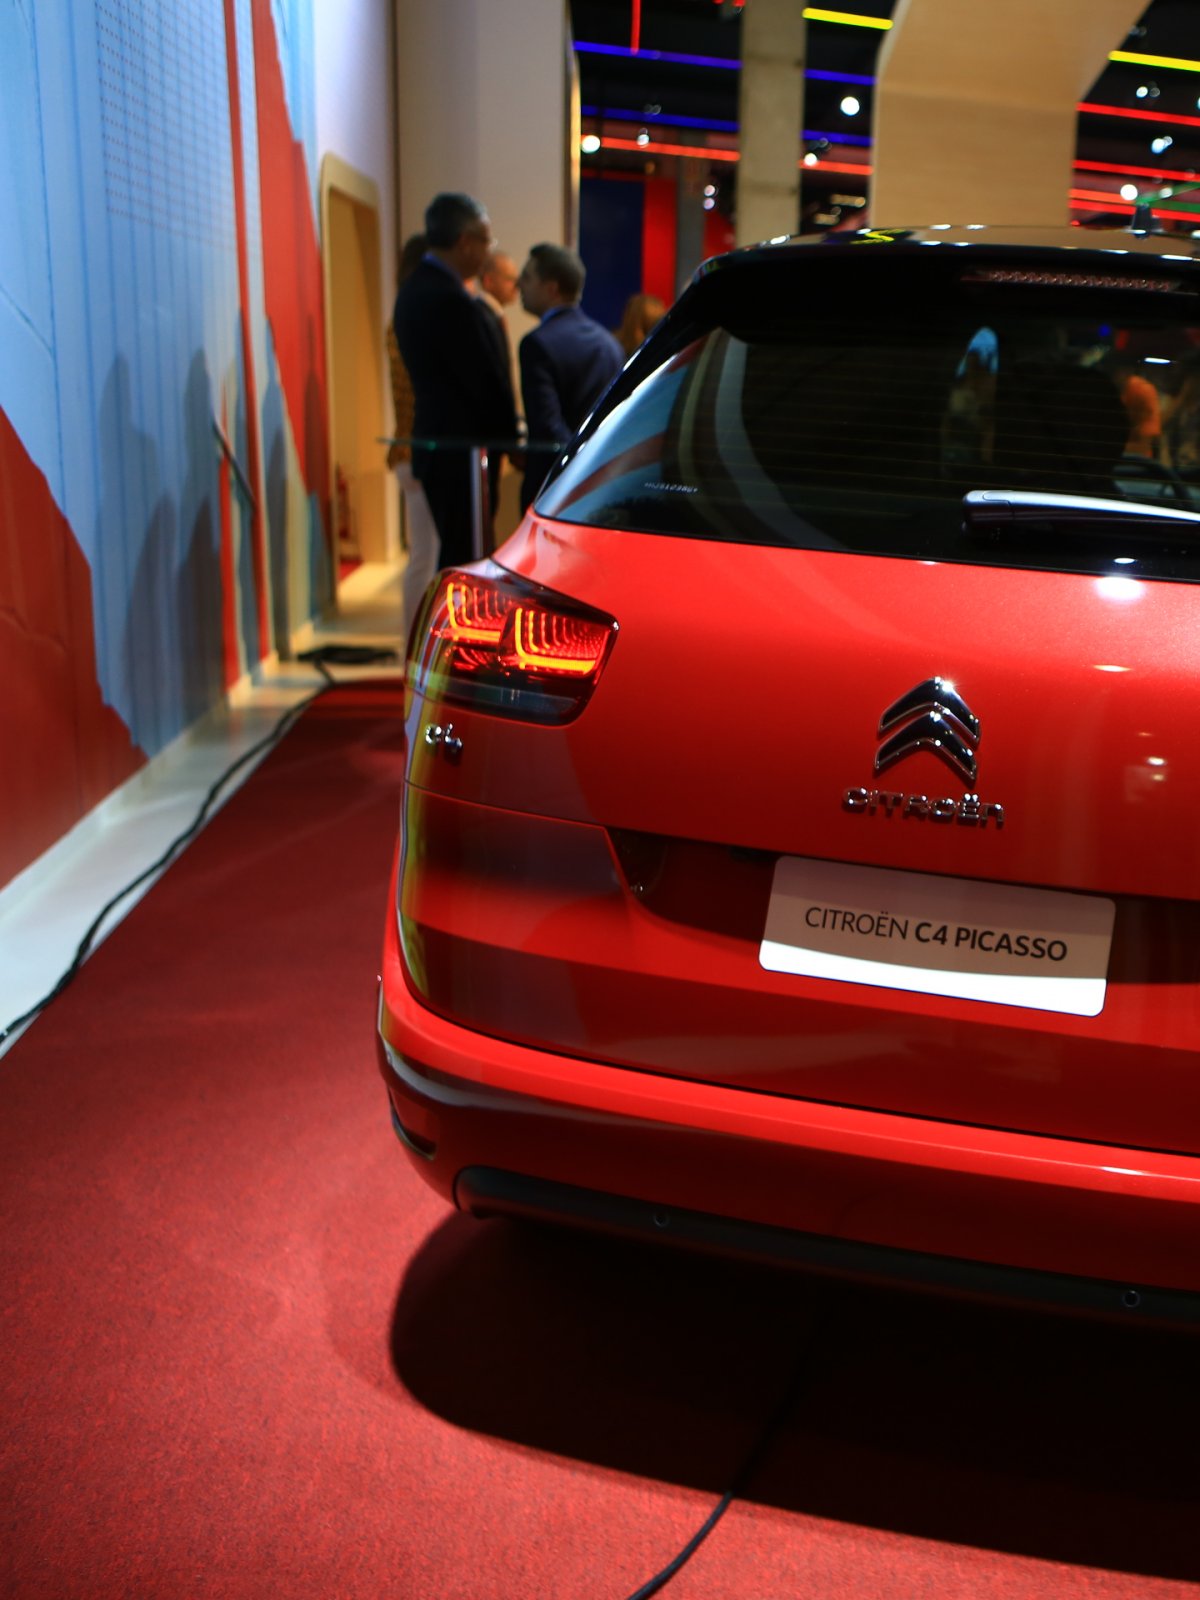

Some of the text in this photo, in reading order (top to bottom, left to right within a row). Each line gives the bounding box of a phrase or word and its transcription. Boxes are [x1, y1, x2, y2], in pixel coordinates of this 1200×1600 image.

[425, 724, 463, 754] C4
[804, 907, 1068, 962] CITROËN C4 PICASSO
